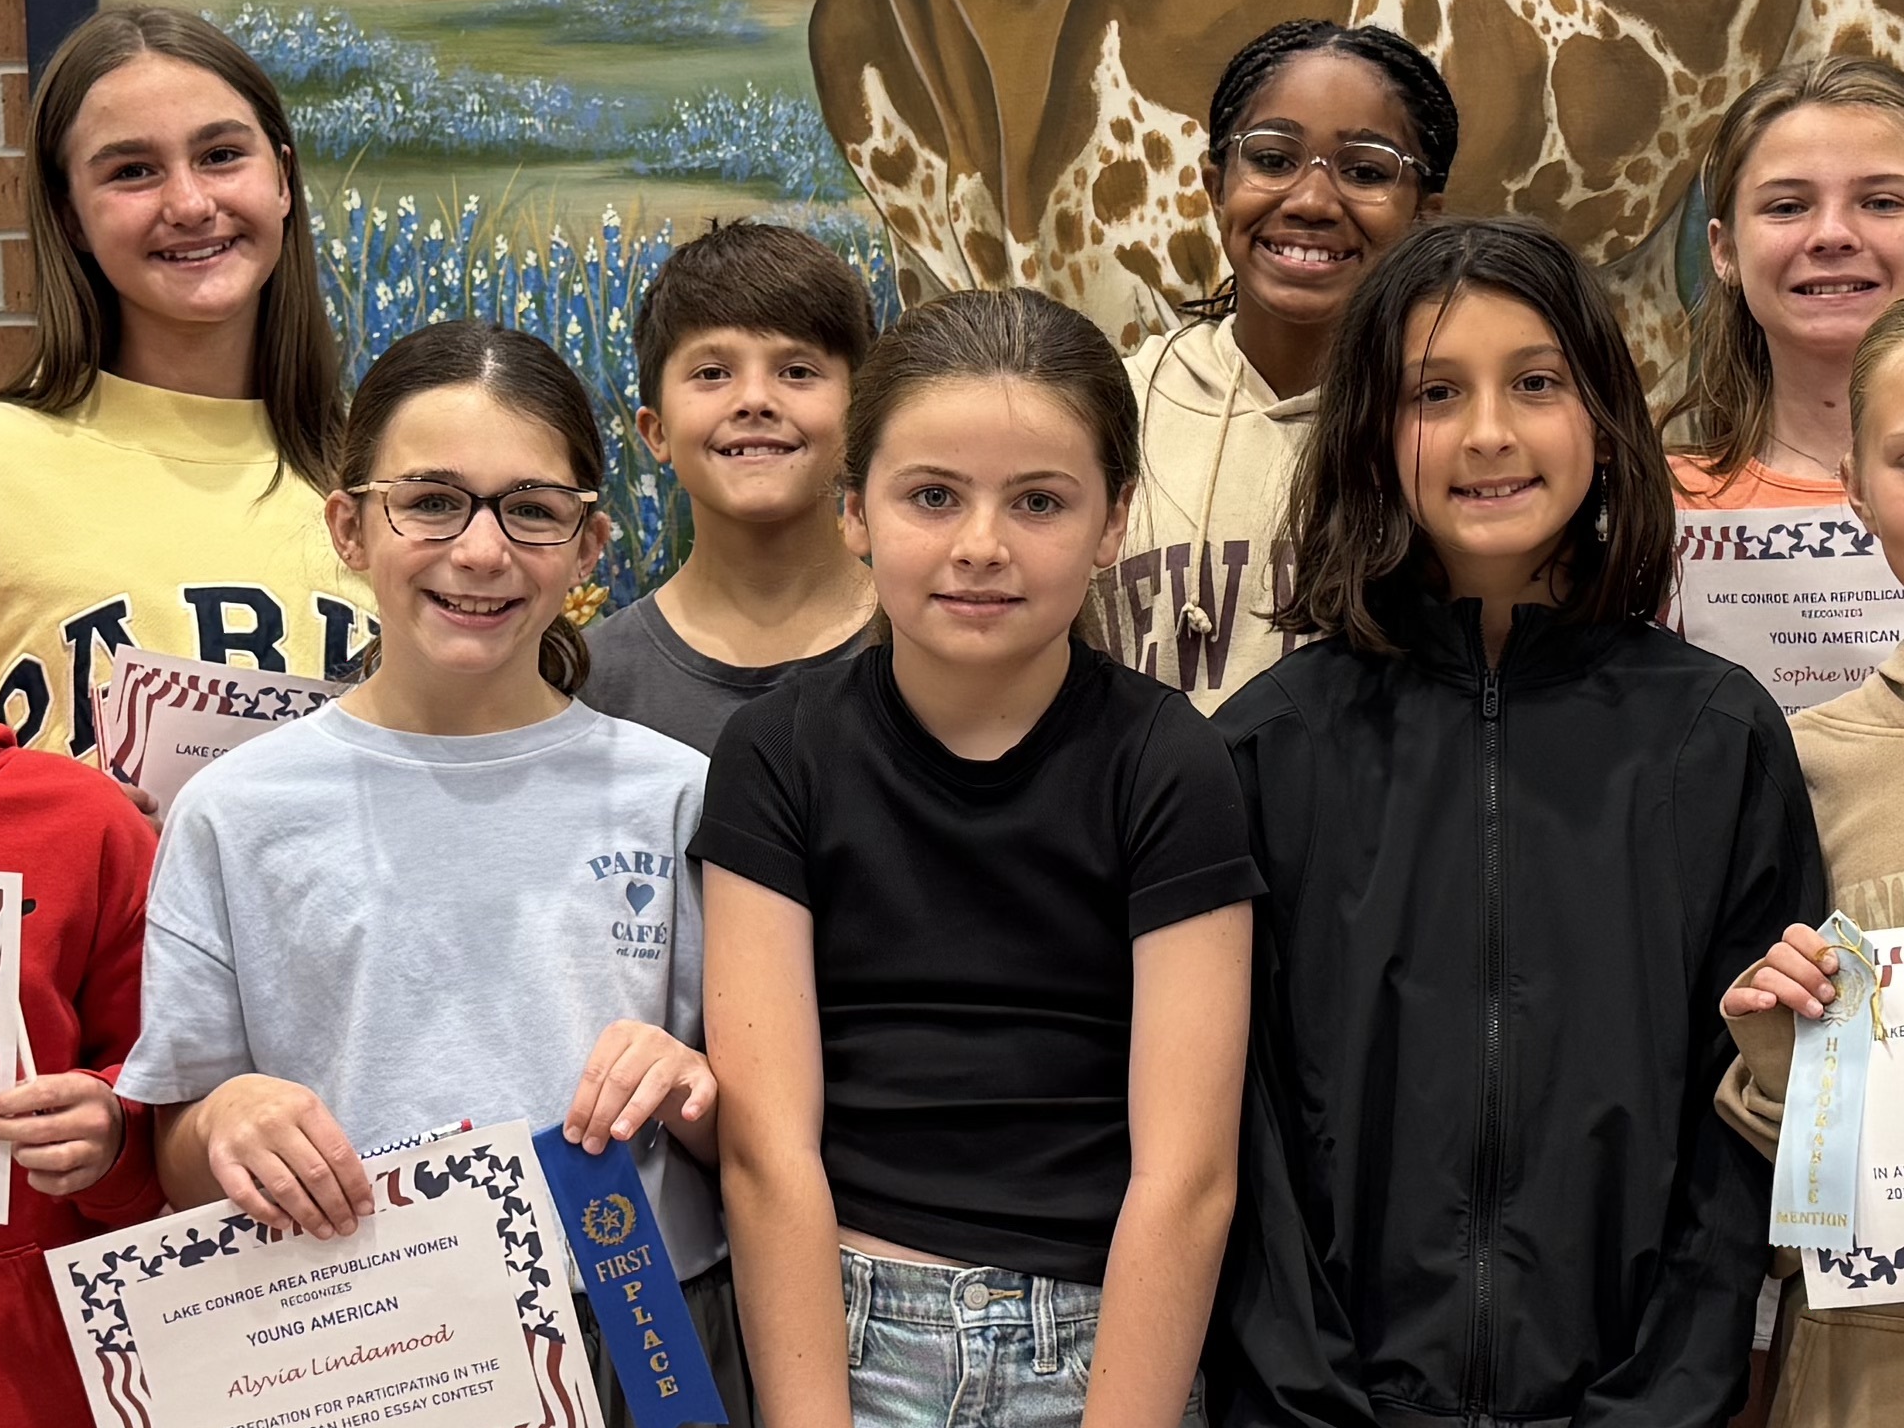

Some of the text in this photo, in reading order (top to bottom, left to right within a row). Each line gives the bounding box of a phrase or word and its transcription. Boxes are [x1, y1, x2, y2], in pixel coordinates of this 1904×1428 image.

[1769, 629, 1900, 645] YOUNG AMERICAN
[1772, 665, 1841, 687] Sophie
[176, 743, 209, 758] LAKE
[586, 850, 675, 882] PARI
[611, 921, 668, 945] CAFÉ
[1873, 1167, 1888, 1180] IN
[162, 1235, 459, 1325] LAKE CONROE AREA REPUBLICAN WOMEN
[595, 1244, 652, 1283] FIRST
[280, 1281, 352, 1309] RECOGNIZES
[246, 1295, 399, 1347] YOUNG AMERICAN
[622, 1280, 679, 1398] PLACE
[227, 1323, 455, 1399] Alyvia Lindamood
[314, 1399, 343, 1417] FOR
[346, 1371, 450, 1409] PARTICIPATING
[453, 1366, 469, 1380] IN
[470, 1358, 500, 1375] THE
[341, 1409, 380, 1428] HERO
[383, 1396, 428, 1419] ESSAY
[431, 1379, 494, 1406] CONTEST
